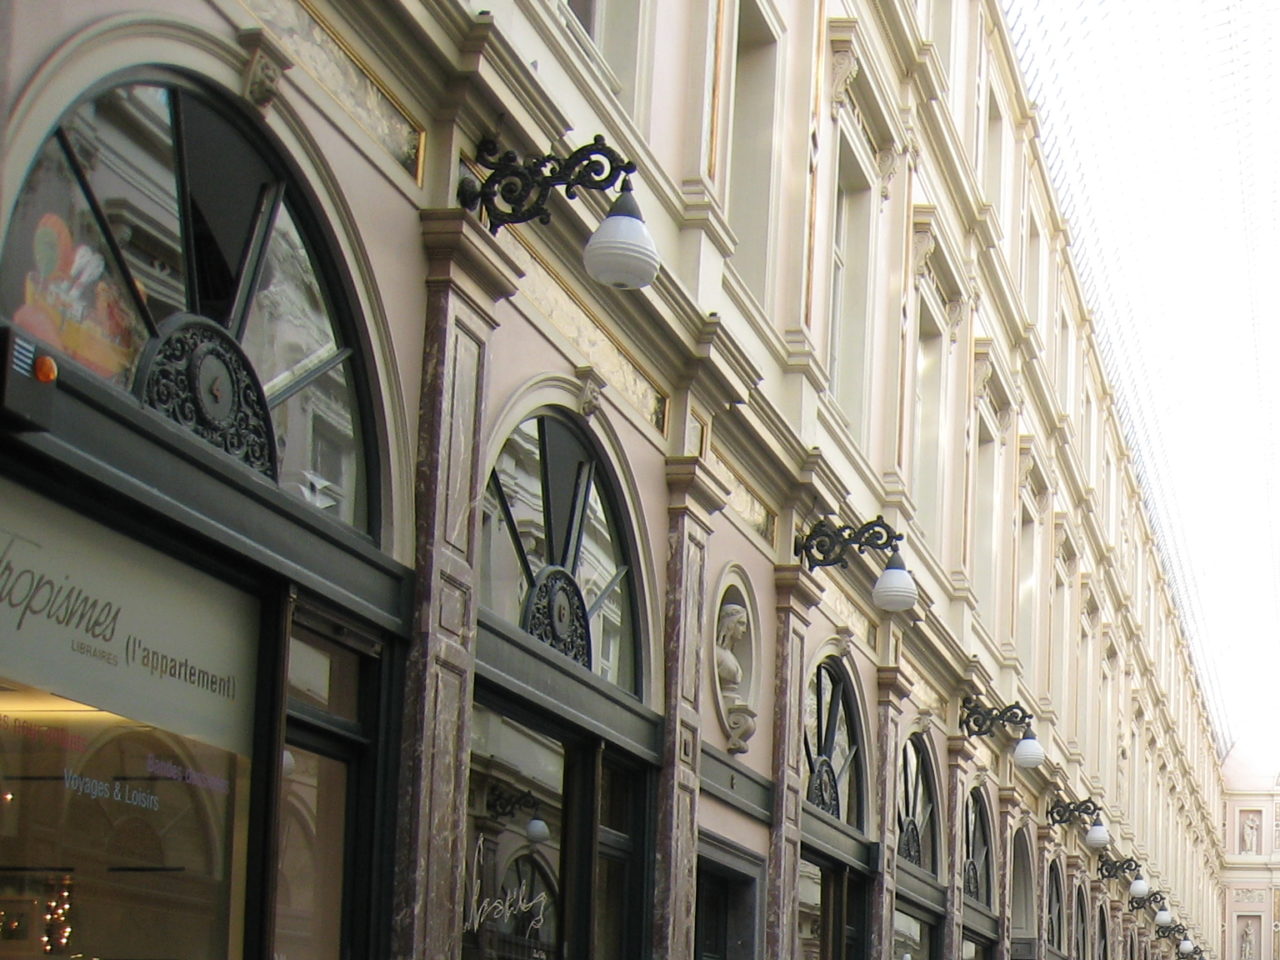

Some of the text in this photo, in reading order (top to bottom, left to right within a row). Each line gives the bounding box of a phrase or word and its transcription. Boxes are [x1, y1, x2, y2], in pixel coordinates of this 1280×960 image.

[71, 640, 119, 667] LIBRAIRES
[125, 635, 237, 700] (l'appartement)
[64, 768, 160, 812] Voyages & Loisirs
